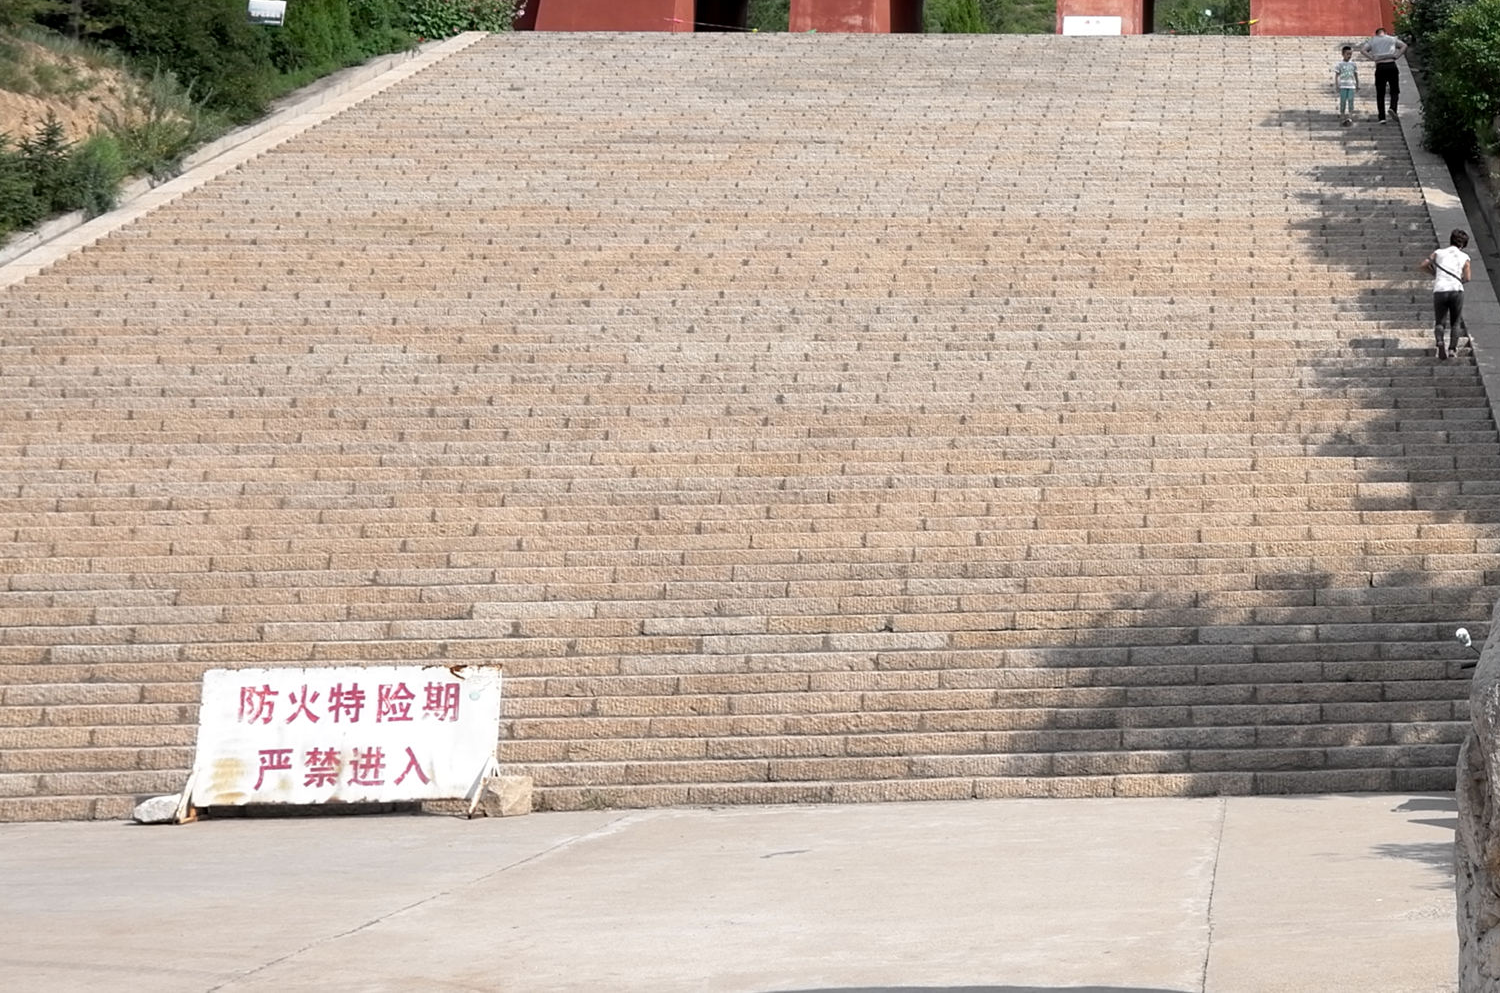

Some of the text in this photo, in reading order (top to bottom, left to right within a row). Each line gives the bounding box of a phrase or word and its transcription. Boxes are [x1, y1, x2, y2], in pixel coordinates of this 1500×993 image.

[237, 681, 461, 725] 防火特险期
[253, 746, 431, 791] 严禁进入
